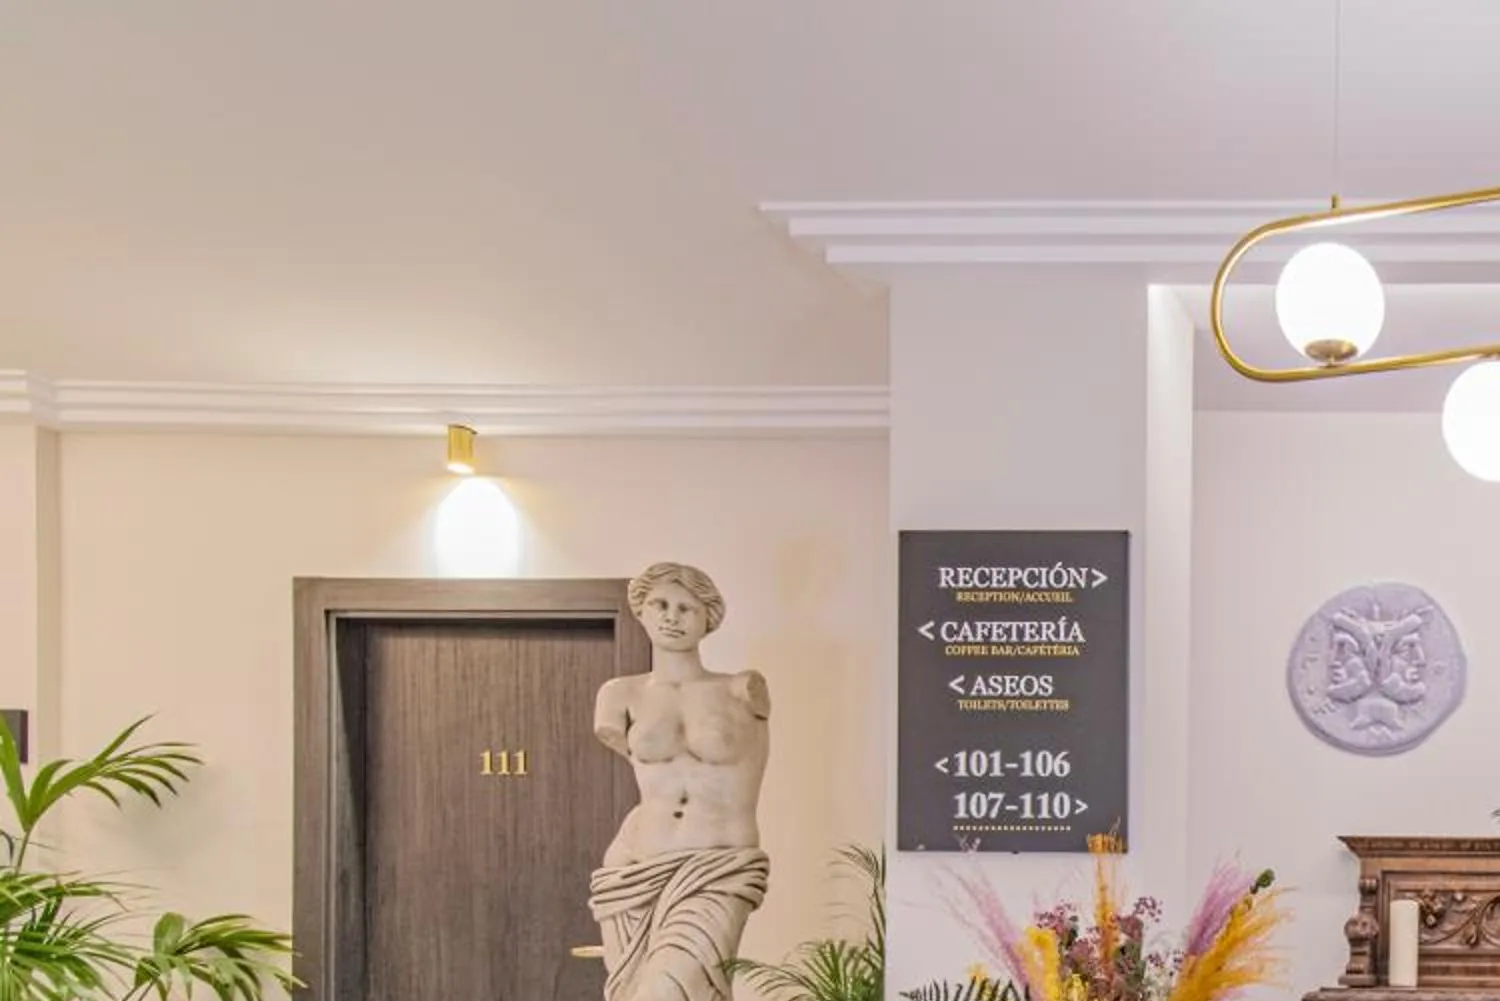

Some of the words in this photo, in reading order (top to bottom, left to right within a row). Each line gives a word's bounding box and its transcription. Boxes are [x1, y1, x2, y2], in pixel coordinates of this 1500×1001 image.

[938, 561, 1089, 589] RECEPCIÓN
[956, 591, 1073, 603] RECEPTION/ACCUEIL
[940, 615, 1086, 643] CAFETERÍA
[945, 645, 989, 657] COFFEE
[970, 675, 1054, 697] ASEOS
[958, 699, 1069, 712] TOILETS/TOILETTES
[480, 749, 528, 775] 111
[953, 750, 1071, 778] 101-106
[953, 792, 1072, 819] 107-110
